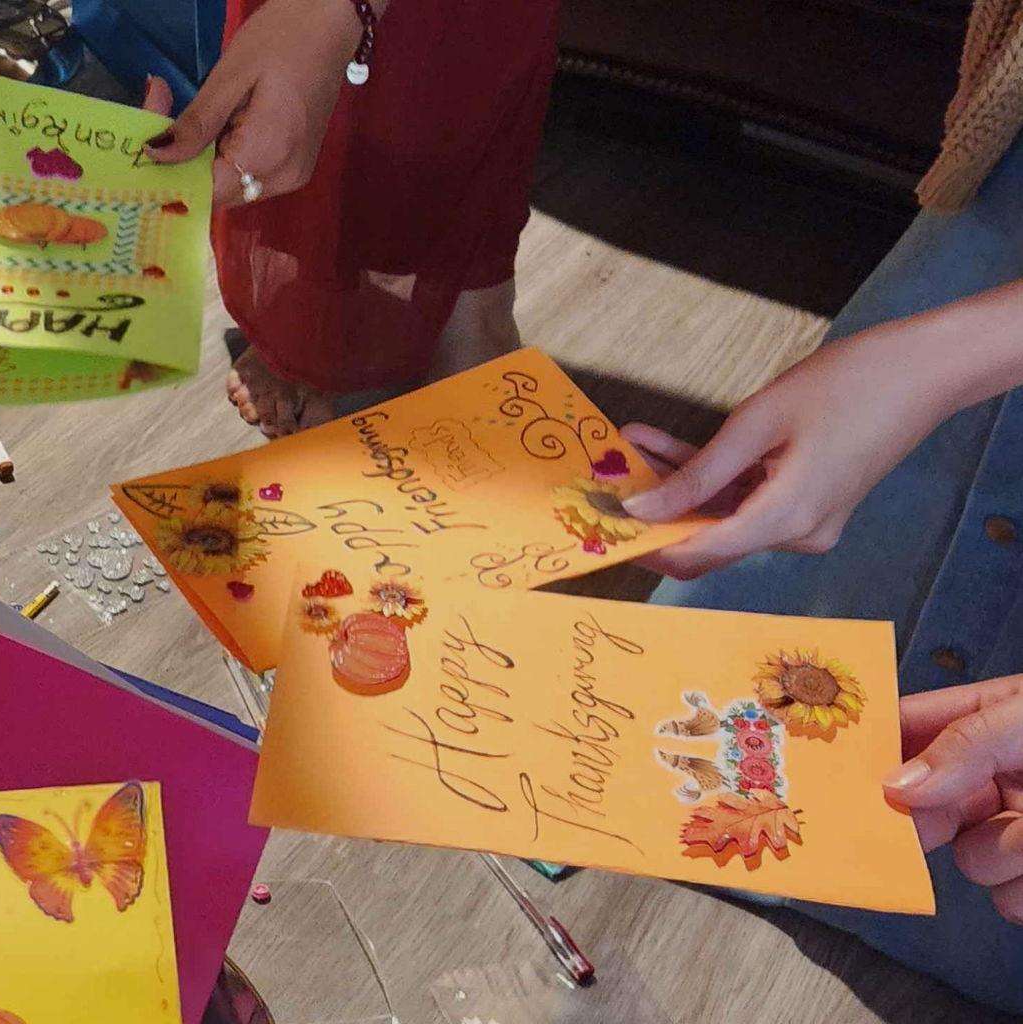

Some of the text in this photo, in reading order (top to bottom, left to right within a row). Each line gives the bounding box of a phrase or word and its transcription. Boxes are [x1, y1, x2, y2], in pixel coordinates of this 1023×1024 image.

[318, 499, 421, 578] appy
[380, 613, 518, 815] Happy
[519, 613, 645, 857] Thanksgiving
